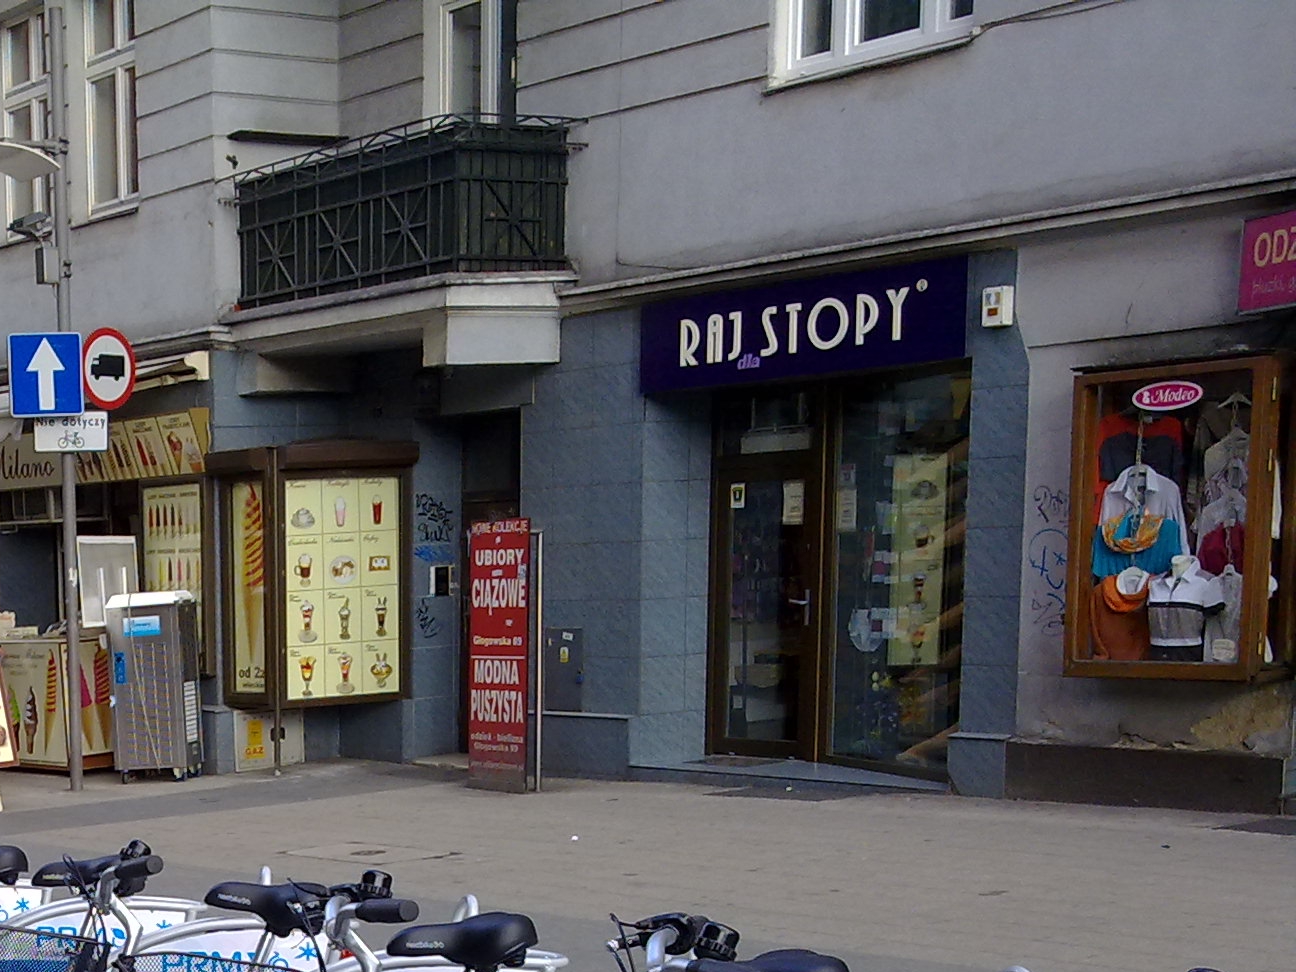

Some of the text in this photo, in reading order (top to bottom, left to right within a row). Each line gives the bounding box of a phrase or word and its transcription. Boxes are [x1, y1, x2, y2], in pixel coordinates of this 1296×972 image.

[1254, 226, 1296, 267] ODZ
[680, 287, 909, 367] RAJ STOPY
[737, 353, 760, 369] dla
[35, 416, 106, 430] Nie dotyczy
[475, 549, 524, 566] UBIORY
[239, 667, 265, 679] od 2z
[474, 659, 519, 685] MODNA
[470, 689, 524, 723] PUSZYSTA
